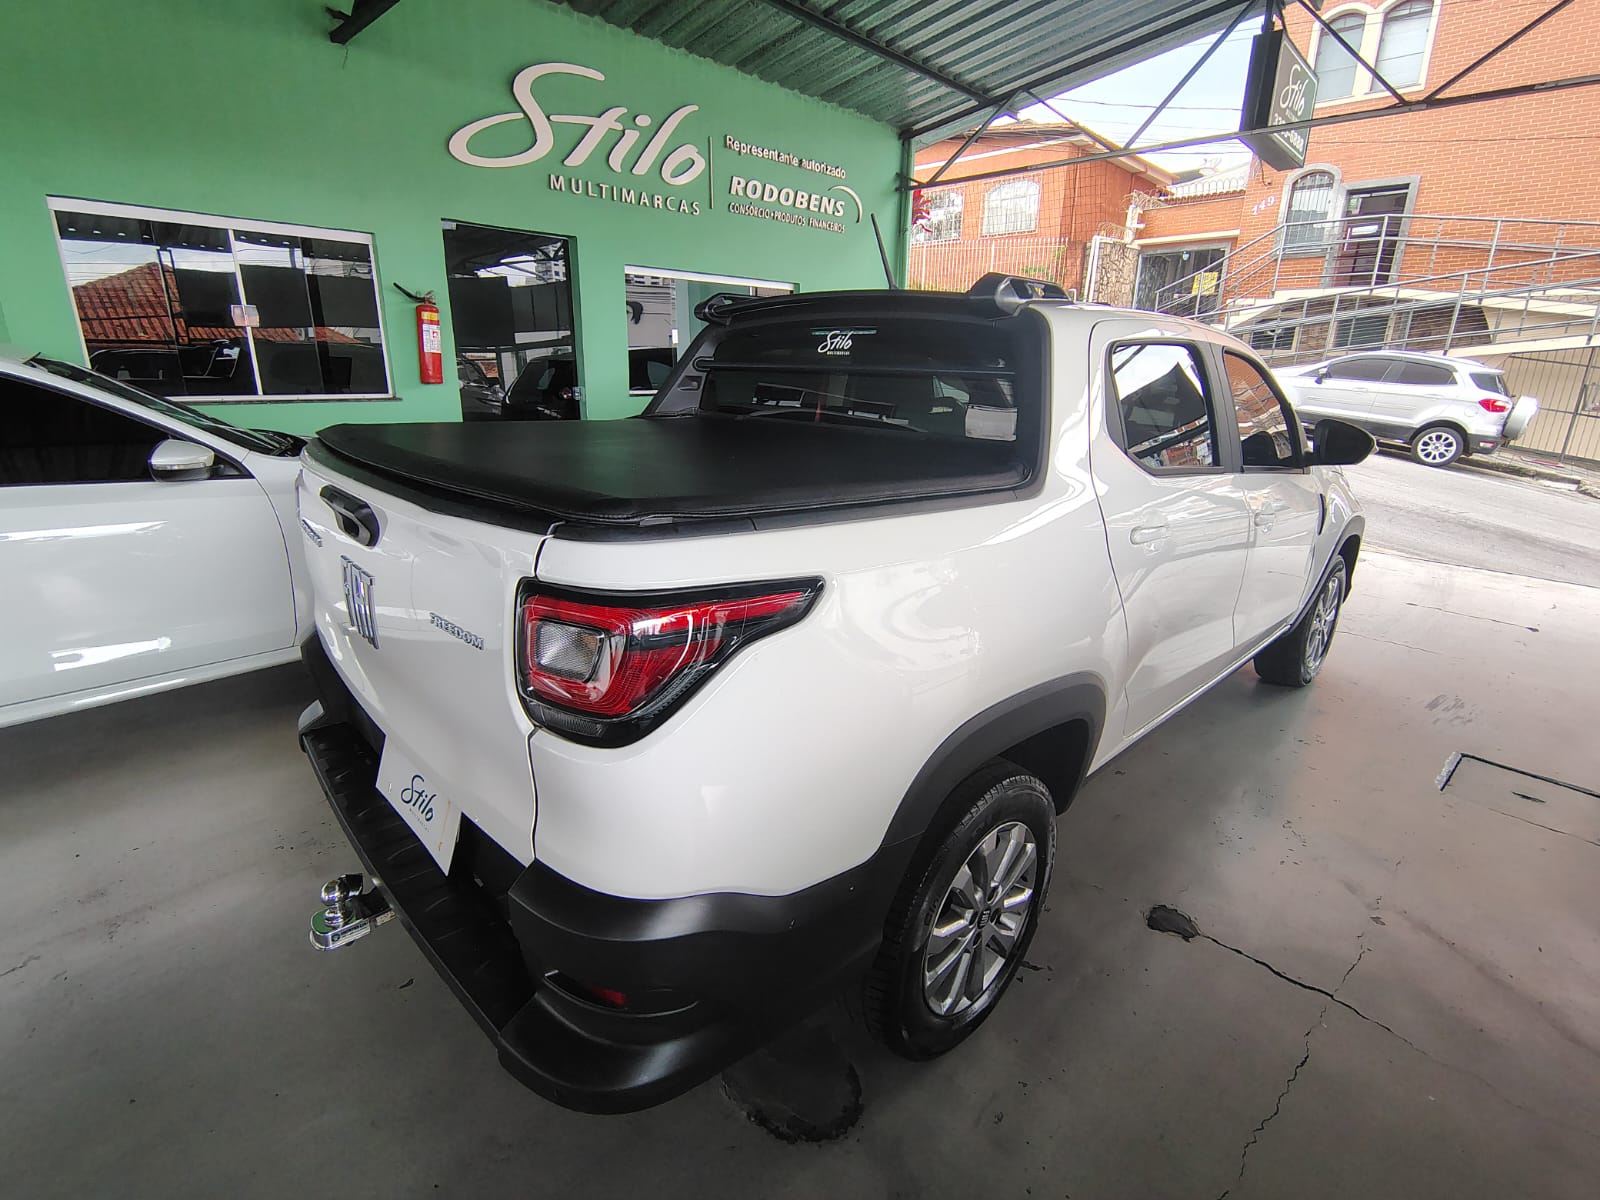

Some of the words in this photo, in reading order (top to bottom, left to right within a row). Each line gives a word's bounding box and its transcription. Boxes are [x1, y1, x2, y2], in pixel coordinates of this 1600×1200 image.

[1280, 64, 1309, 116] Stilo
[449, 62, 706, 185] Stilo
[725, 134, 799, 167] Representante
[800, 158, 846, 179] autorizado
[549, 174, 700, 216] MULTIMARCAS
[730, 176, 846, 217] RODOBENS
[773, 211, 806, 227] PRODUTOS
[817, 330, 854, 353] Stilo
[341, 554, 379, 650] FIAT
[430, 612, 485, 651] FREEDOM
[401, 774, 437, 822] Stilo
